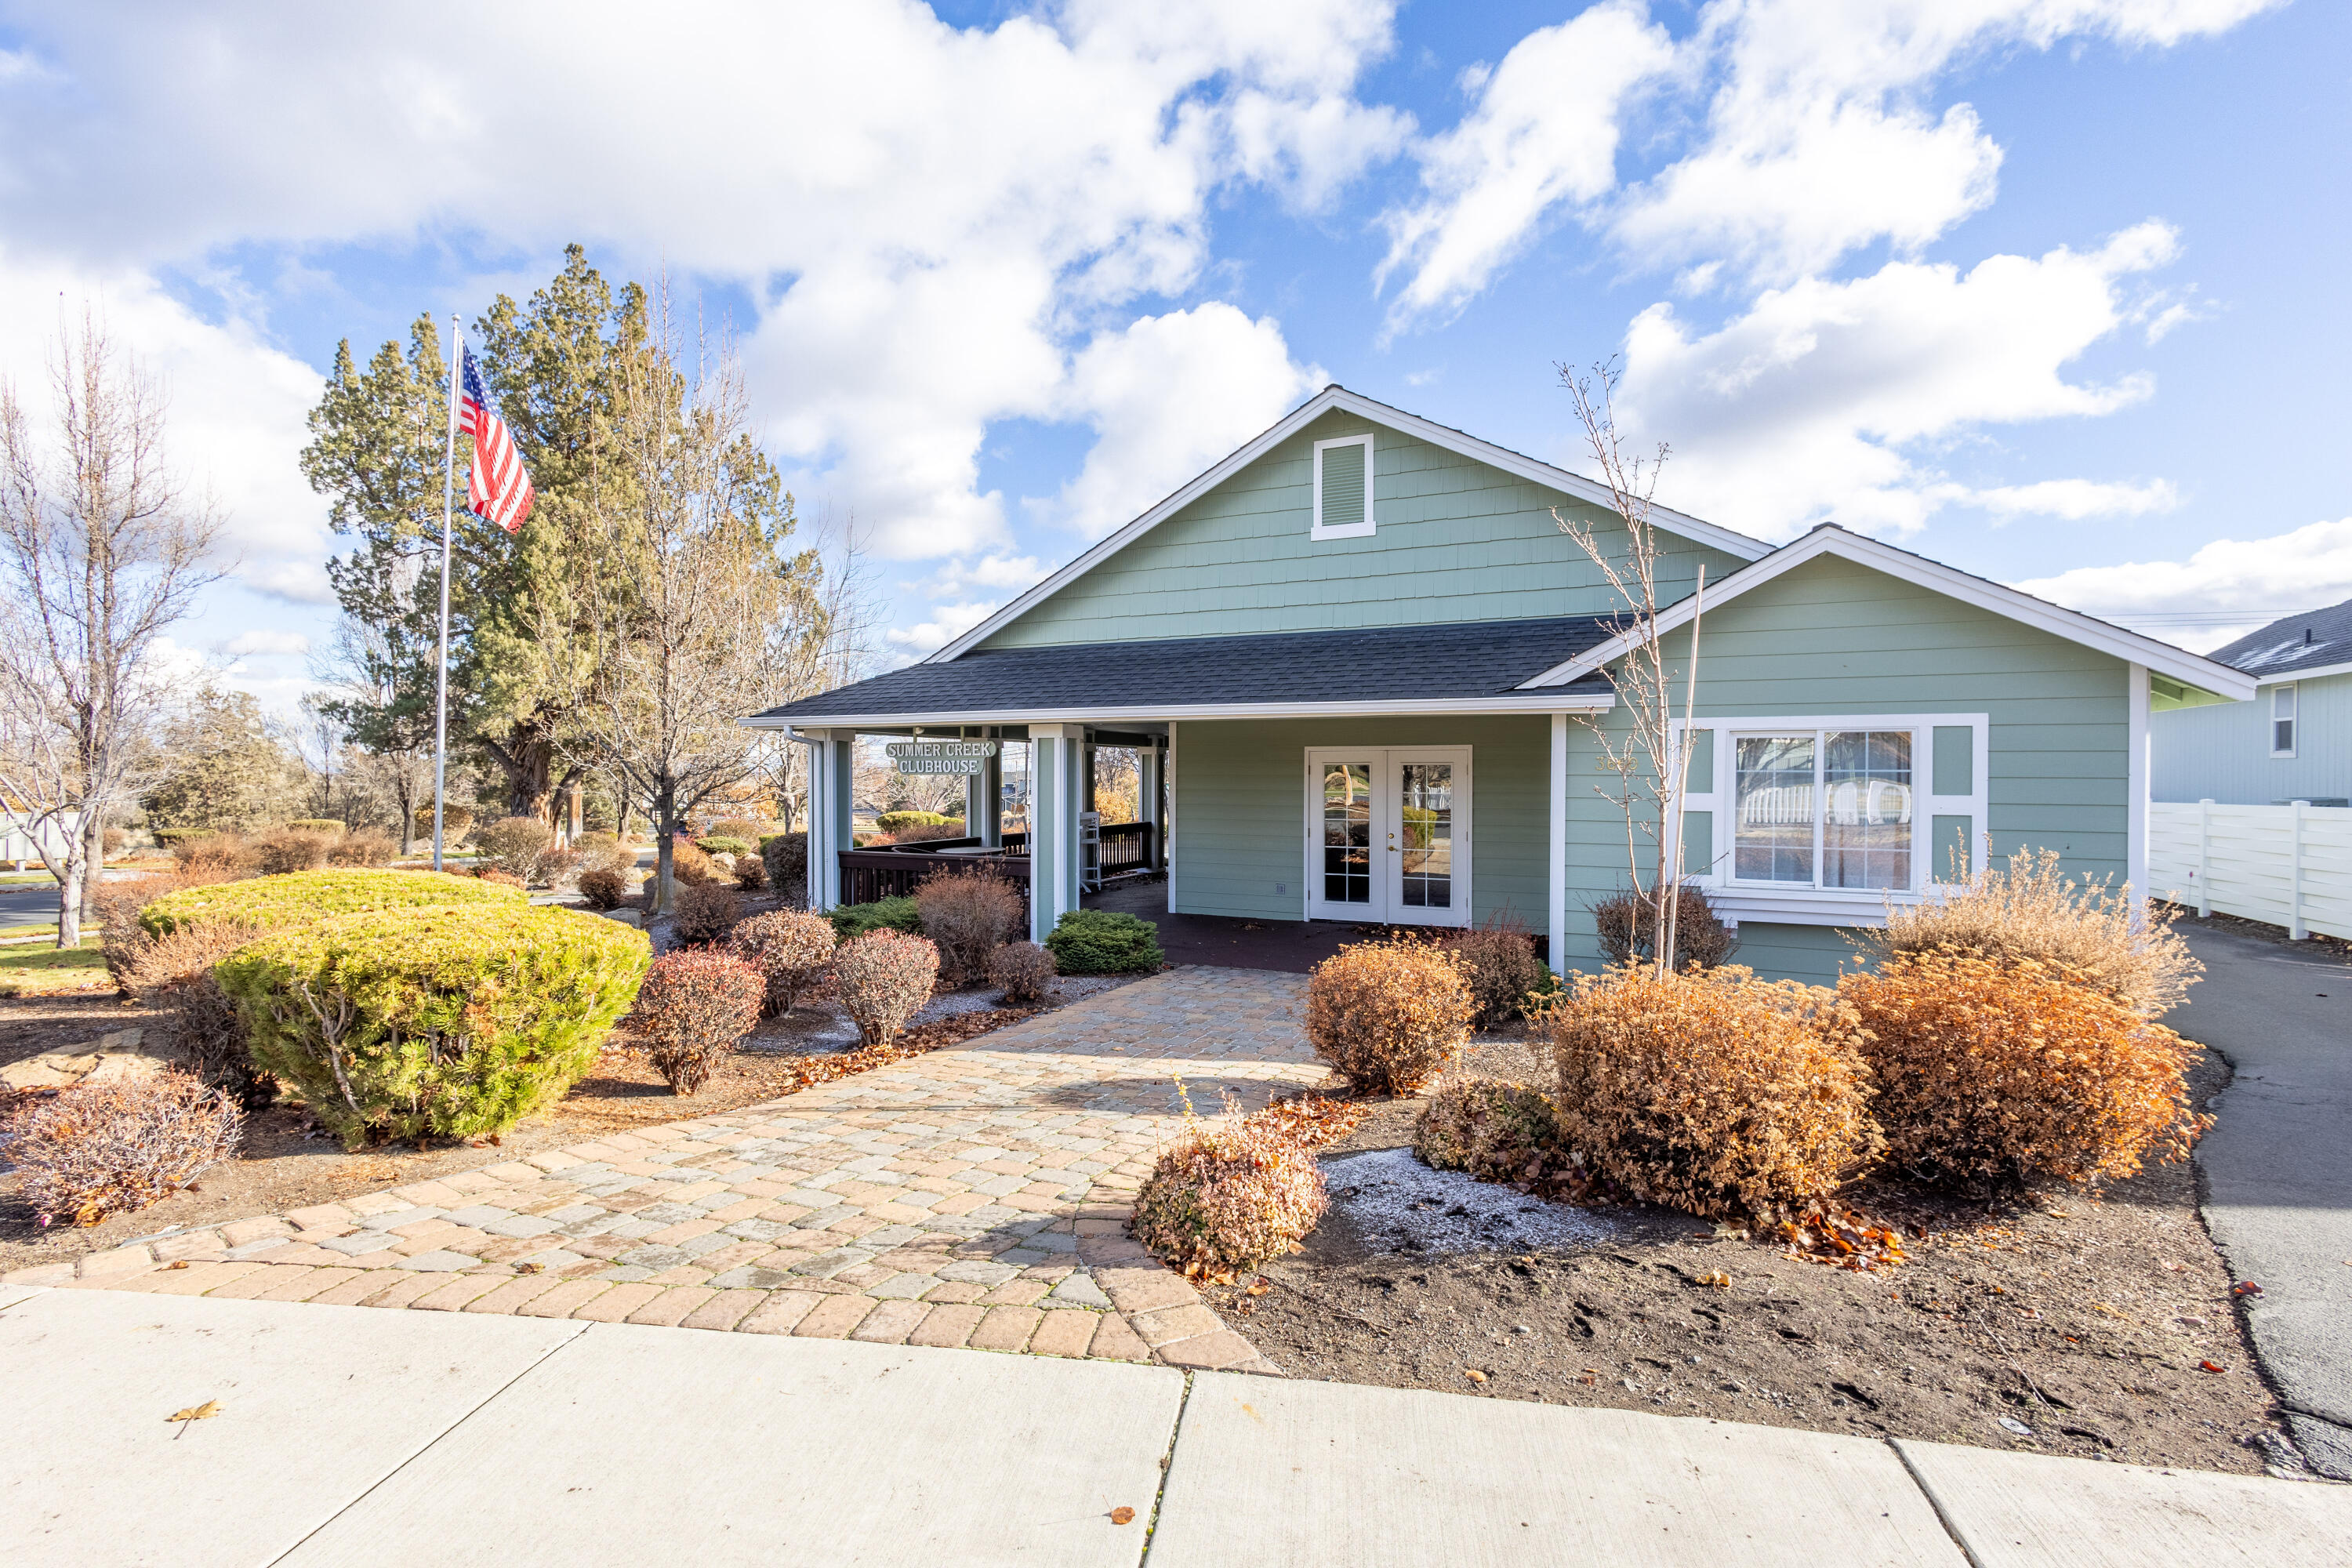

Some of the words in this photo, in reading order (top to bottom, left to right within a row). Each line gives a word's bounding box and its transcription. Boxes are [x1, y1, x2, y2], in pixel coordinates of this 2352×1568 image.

[888, 743, 941, 757] SUMMER
[946, 742, 990, 757] CREEK
[899, 760, 978, 773] CLUBHOUSE
